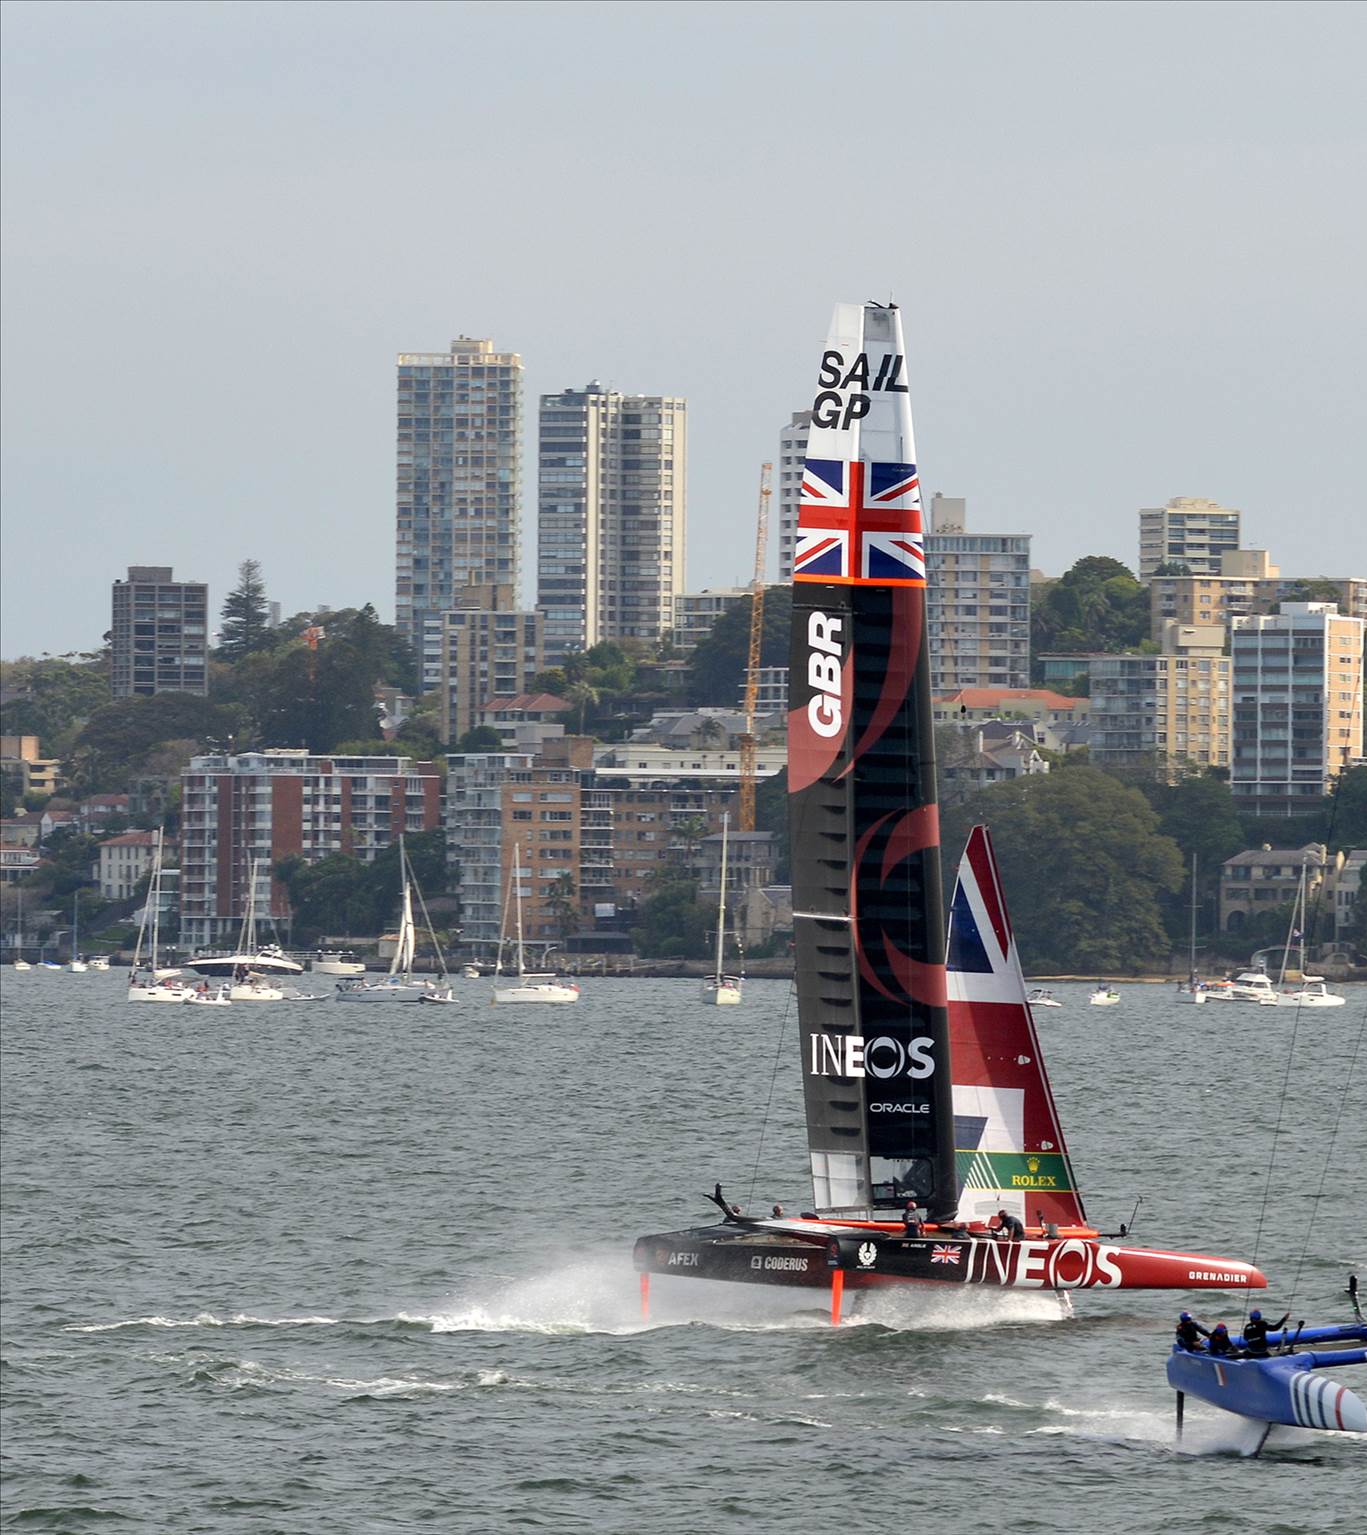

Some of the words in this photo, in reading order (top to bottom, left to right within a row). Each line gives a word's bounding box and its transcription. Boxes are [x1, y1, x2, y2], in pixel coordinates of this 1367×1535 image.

[818, 350, 908, 392] SAIL
[811, 391, 871, 430] GP
[808, 611, 842, 737] GBR
[809, 1033, 935, 1079] INEOS
[870, 1103, 930, 1114] ORACLE
[1012, 1175, 1056, 1187] ROLEX
[668, 1252, 699, 1266] AFEX
[764, 1257, 808, 1271] CODERUS
[965, 1238, 1123, 1288] INEOS
[1188, 1270, 1247, 1283] GRENADIER
